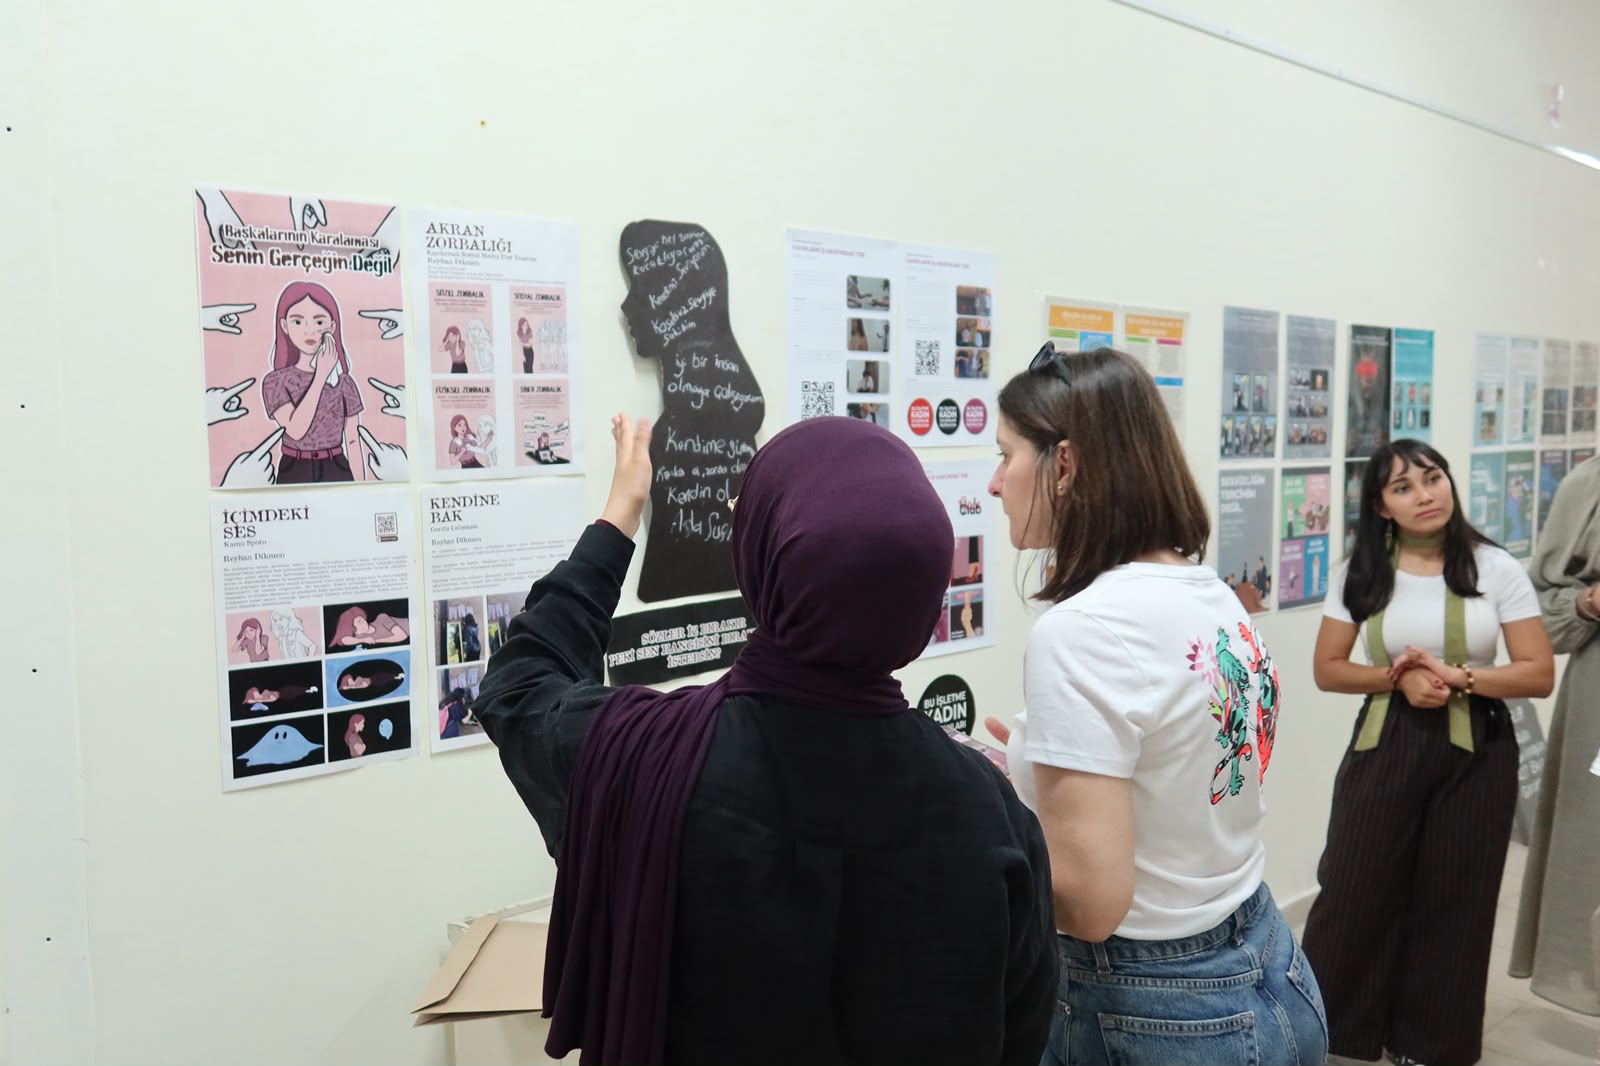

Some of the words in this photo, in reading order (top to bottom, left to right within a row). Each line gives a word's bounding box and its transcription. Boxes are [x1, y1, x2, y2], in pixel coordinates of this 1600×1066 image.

[225, 223, 308, 244] Başkalarının
[310, 231, 379, 249] Karalaması
[426, 221, 484, 237] AKRAN
[426, 236, 512, 253] ZORBALIĞI
[212, 245, 264, 266] Senin
[269, 249, 348, 274] Gerçeğin
[351, 252, 393, 277] Değil
[692, 352, 708, 369] bir
[430, 493, 501, 510] KENDİNE
[222, 504, 310, 526] İÇİMDEKİ
[430, 509, 463, 524] BAK
[223, 525, 257, 540] SES
[223, 553, 253, 564] Reyhan
[254, 551, 286, 561] Dikmen
[641, 627, 686, 646] SÖZLER
[699, 616, 747, 636] BIRAKIR
[636, 645, 660, 660] SEN
[660, 634, 720, 656] HANGİSİNİ
[923, 698, 935, 709] BU
[936, 690, 967, 708] İŞLETME
